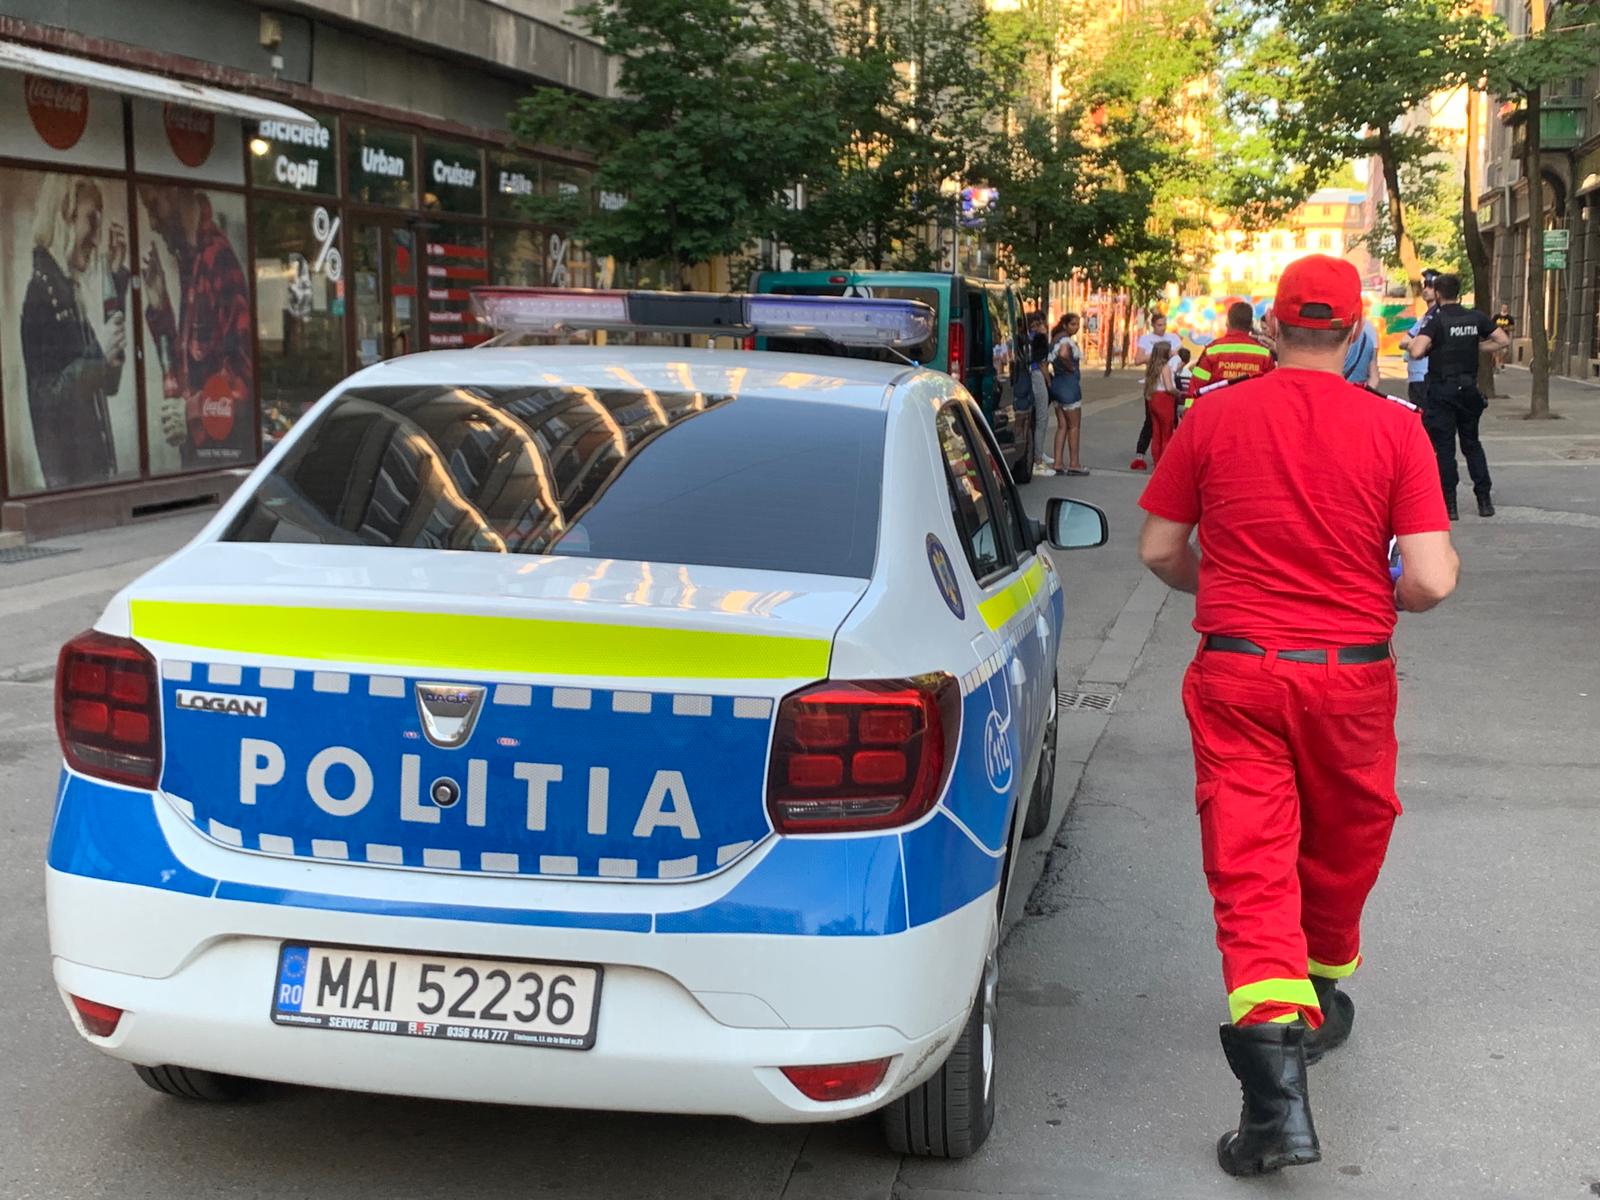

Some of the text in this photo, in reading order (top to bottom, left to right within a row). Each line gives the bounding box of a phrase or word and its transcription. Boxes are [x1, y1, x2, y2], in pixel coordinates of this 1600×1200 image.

[274, 154, 319, 188] Copii
[361, 145, 405, 176] Urban
[432, 158, 477, 188] Cruiser
[1450, 325, 1478, 336] POLITIA
[177, 693, 263, 716] LOGAN
[239, 737, 701, 839] POLITIA
[280, 983, 302, 1005] RO
[316, 956, 577, 1025] MAI 52236
[328, 1016, 370, 1031] SERVICE
[371, 1020, 398, 1032] AUTO
[471, 1028, 490, 1040] 444
[490, 1030, 509, 1041] 777
